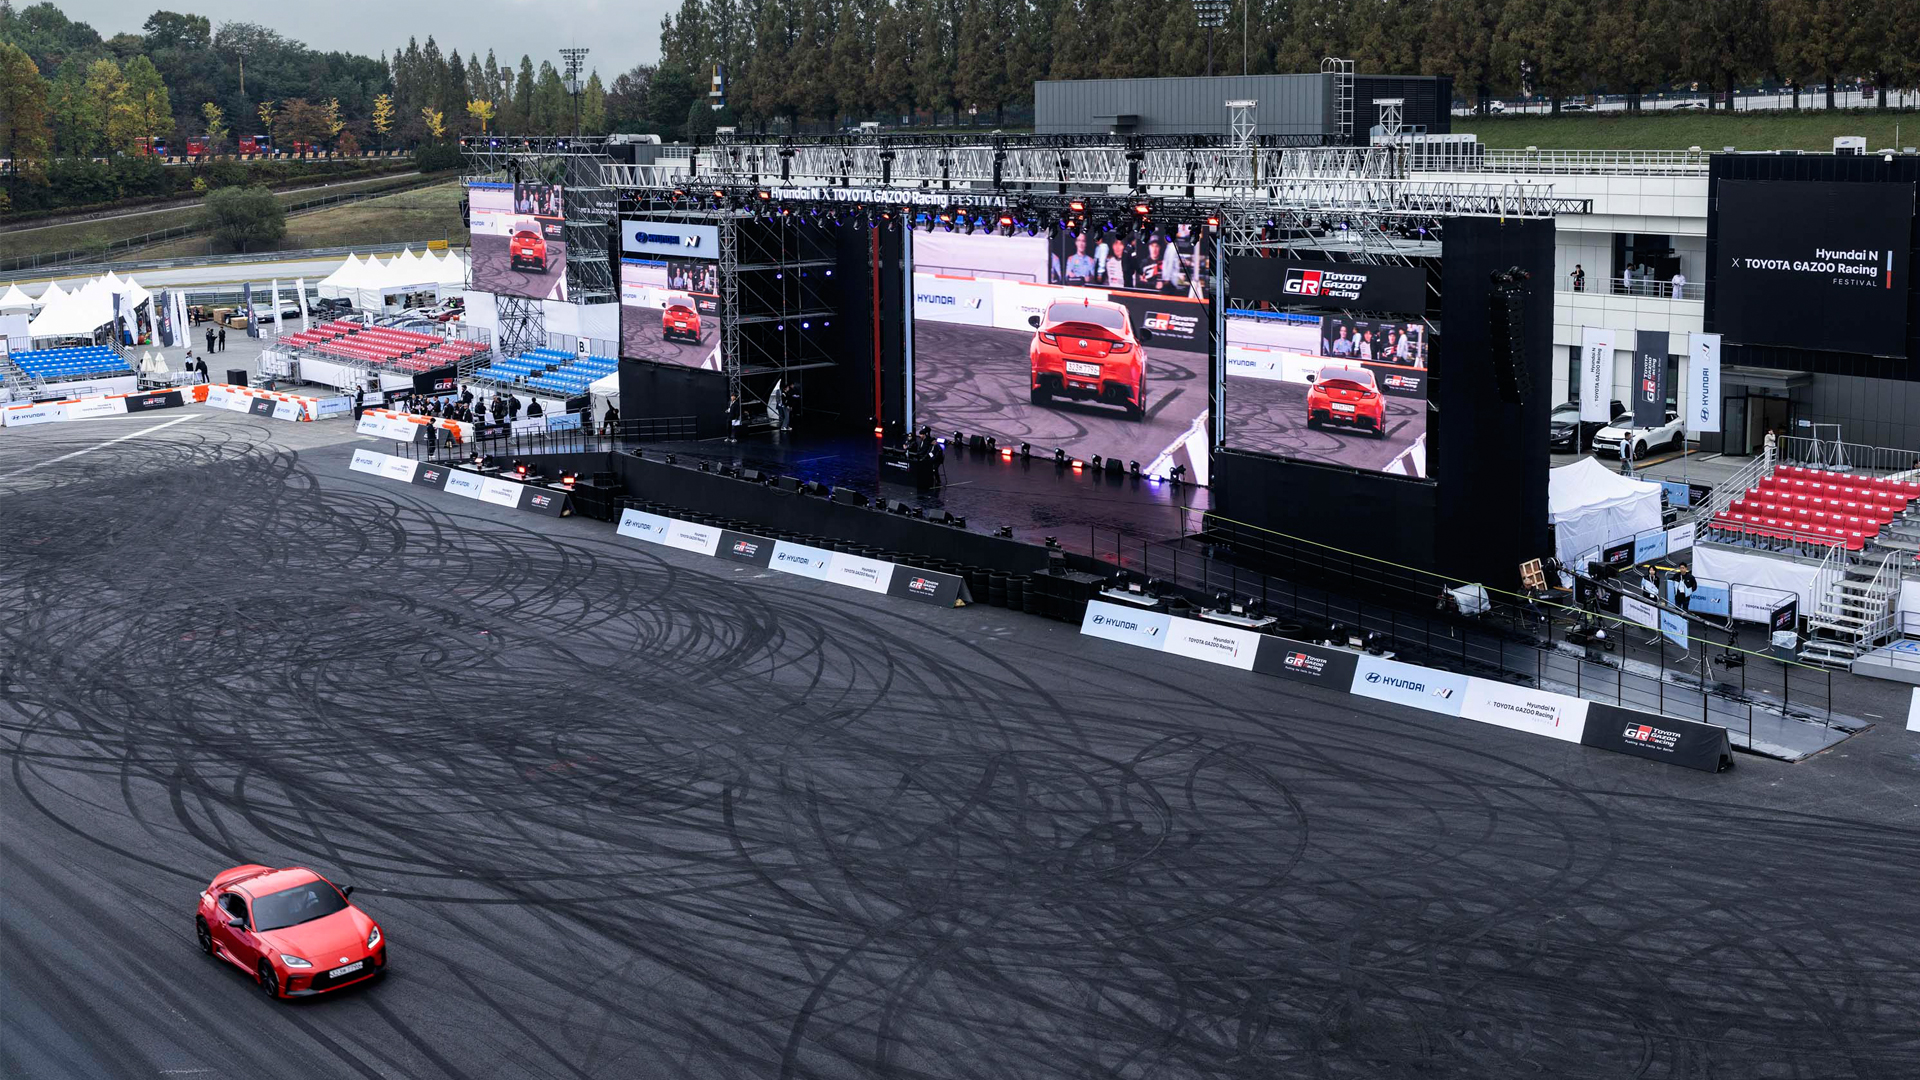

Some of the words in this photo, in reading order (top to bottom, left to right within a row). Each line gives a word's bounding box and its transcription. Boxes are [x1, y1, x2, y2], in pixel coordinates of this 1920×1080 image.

[771, 187, 810, 201] Hyundai
[810, 188, 819, 200] N
[822, 189, 830, 200] X
[832, 189, 873, 203] TOYOTA
[873, 190, 910, 204] GAZOO
[912, 191, 949, 208] Racing
[951, 194, 1007, 207] FESTIVAL
[1815, 248, 1866, 261] Hyundai
[1868, 251, 1878, 260] N
[1731, 257, 1740, 267] X
[1745, 258, 1790, 270] TOYOTA
[1793, 261, 1835, 273] GAZOO
[1838, 263, 1878, 277] Racing
[1324, 271, 1367, 282] TOYOTA
[1285, 278, 1319, 294] GR
[1322, 280, 1362, 290] GAZOO
[1832, 278, 1877, 287] FESTIVAL
[917, 293, 956, 305] HYUNDAI
[1320, 288, 1360, 300] Racing
[446, 327, 452, 337] A
[579, 341, 585, 352] B
[1228, 359, 1256, 367] HYUNDAI
[1701, 368, 1709, 406] HYUNDAI
[786, 555, 809, 565] HYUNDAI
[1106, 618, 1138, 631] HYUNDAI
[1188, 637, 1203, 646] TOYOTA
[1203, 640, 1219, 648] GAZOO
[1219, 644, 1234, 652] Racing
[1213, 635, 1231, 644] Hyundai
[1306, 655, 1327, 664] TOYOTA
[1383, 676, 1425, 693] HYUNDAI
[1493, 701, 1514, 711] TOYOTA
[1515, 706, 1535, 715] GAZOO
[1535, 711, 1554, 720] Racing
[1526, 701, 1550, 711] Hyundai
[1624, 728, 1651, 741] GR
[1650, 732, 1677, 742] GAZOO
[1653, 728, 1681, 738] TOYOTA
[1648, 737, 1675, 748] Racing
